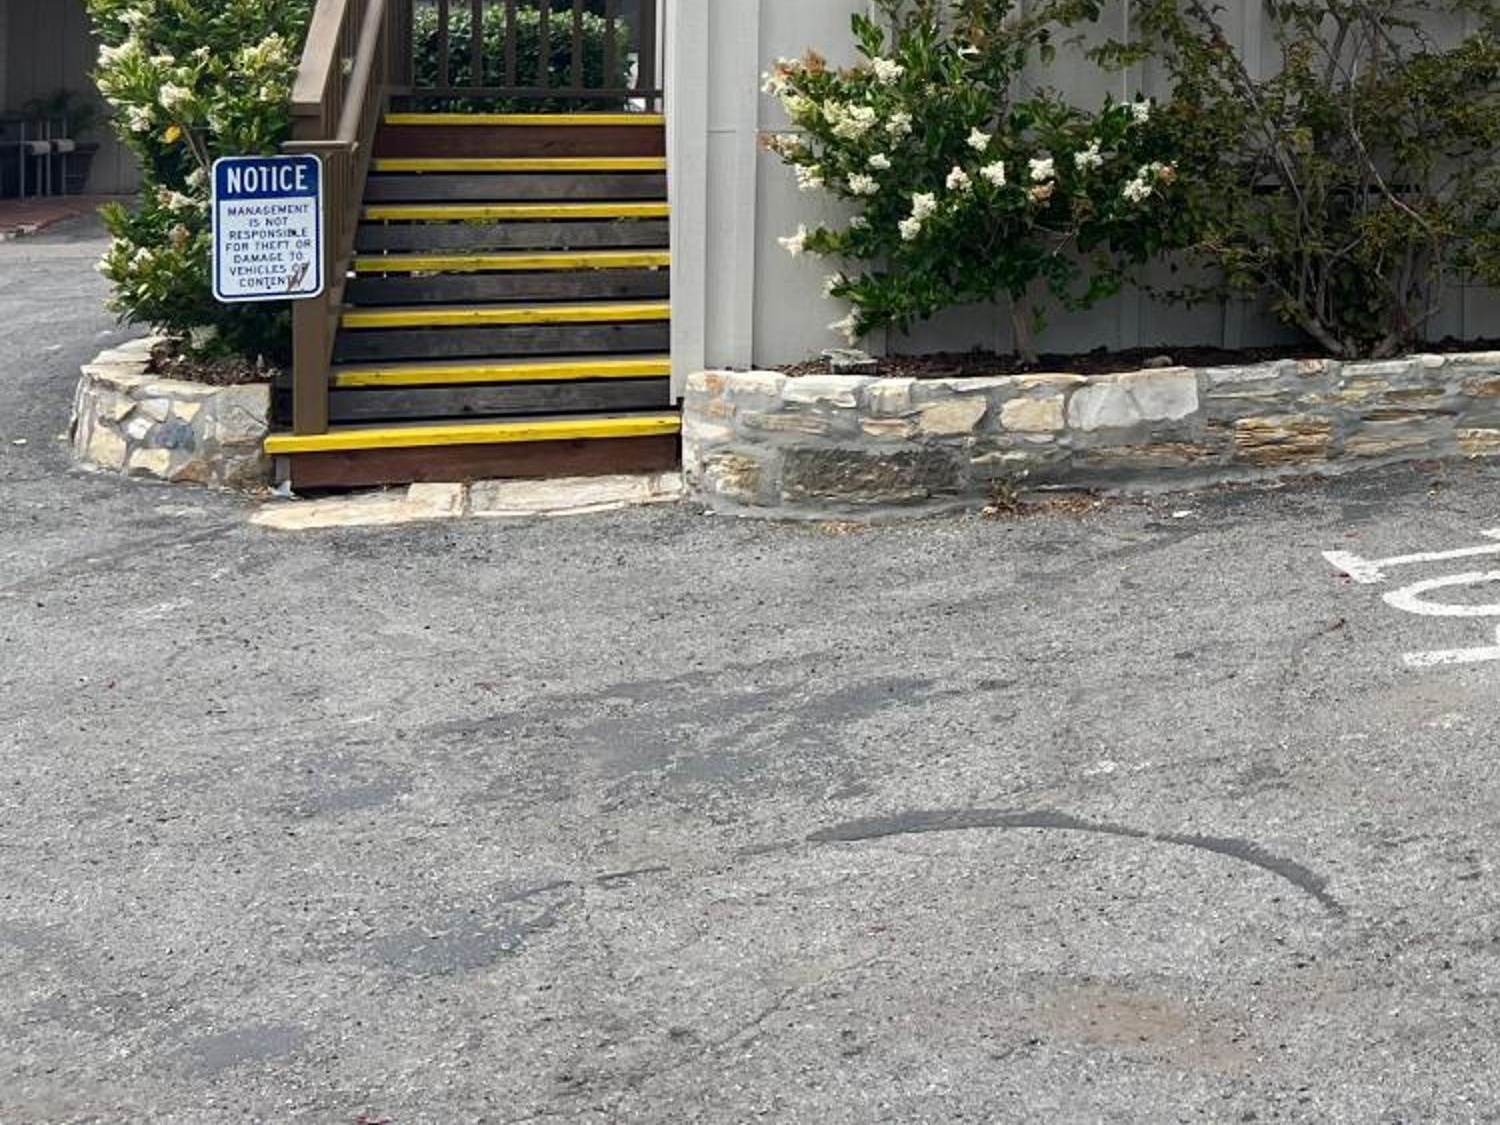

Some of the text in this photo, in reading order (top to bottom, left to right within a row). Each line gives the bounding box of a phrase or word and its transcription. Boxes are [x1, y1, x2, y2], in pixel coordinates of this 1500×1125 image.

[227, 165, 308, 193] NOTICE
[227, 204, 309, 216] MANAGEMENT
[249, 216, 288, 227] IS NOT
[229, 227, 309, 240] RESPONSIBLE
[226, 238, 311, 252] FOR THEFT OR
[233, 251, 303, 264] DAMAGE TO
[229, 264, 287, 276] VEHICLES
